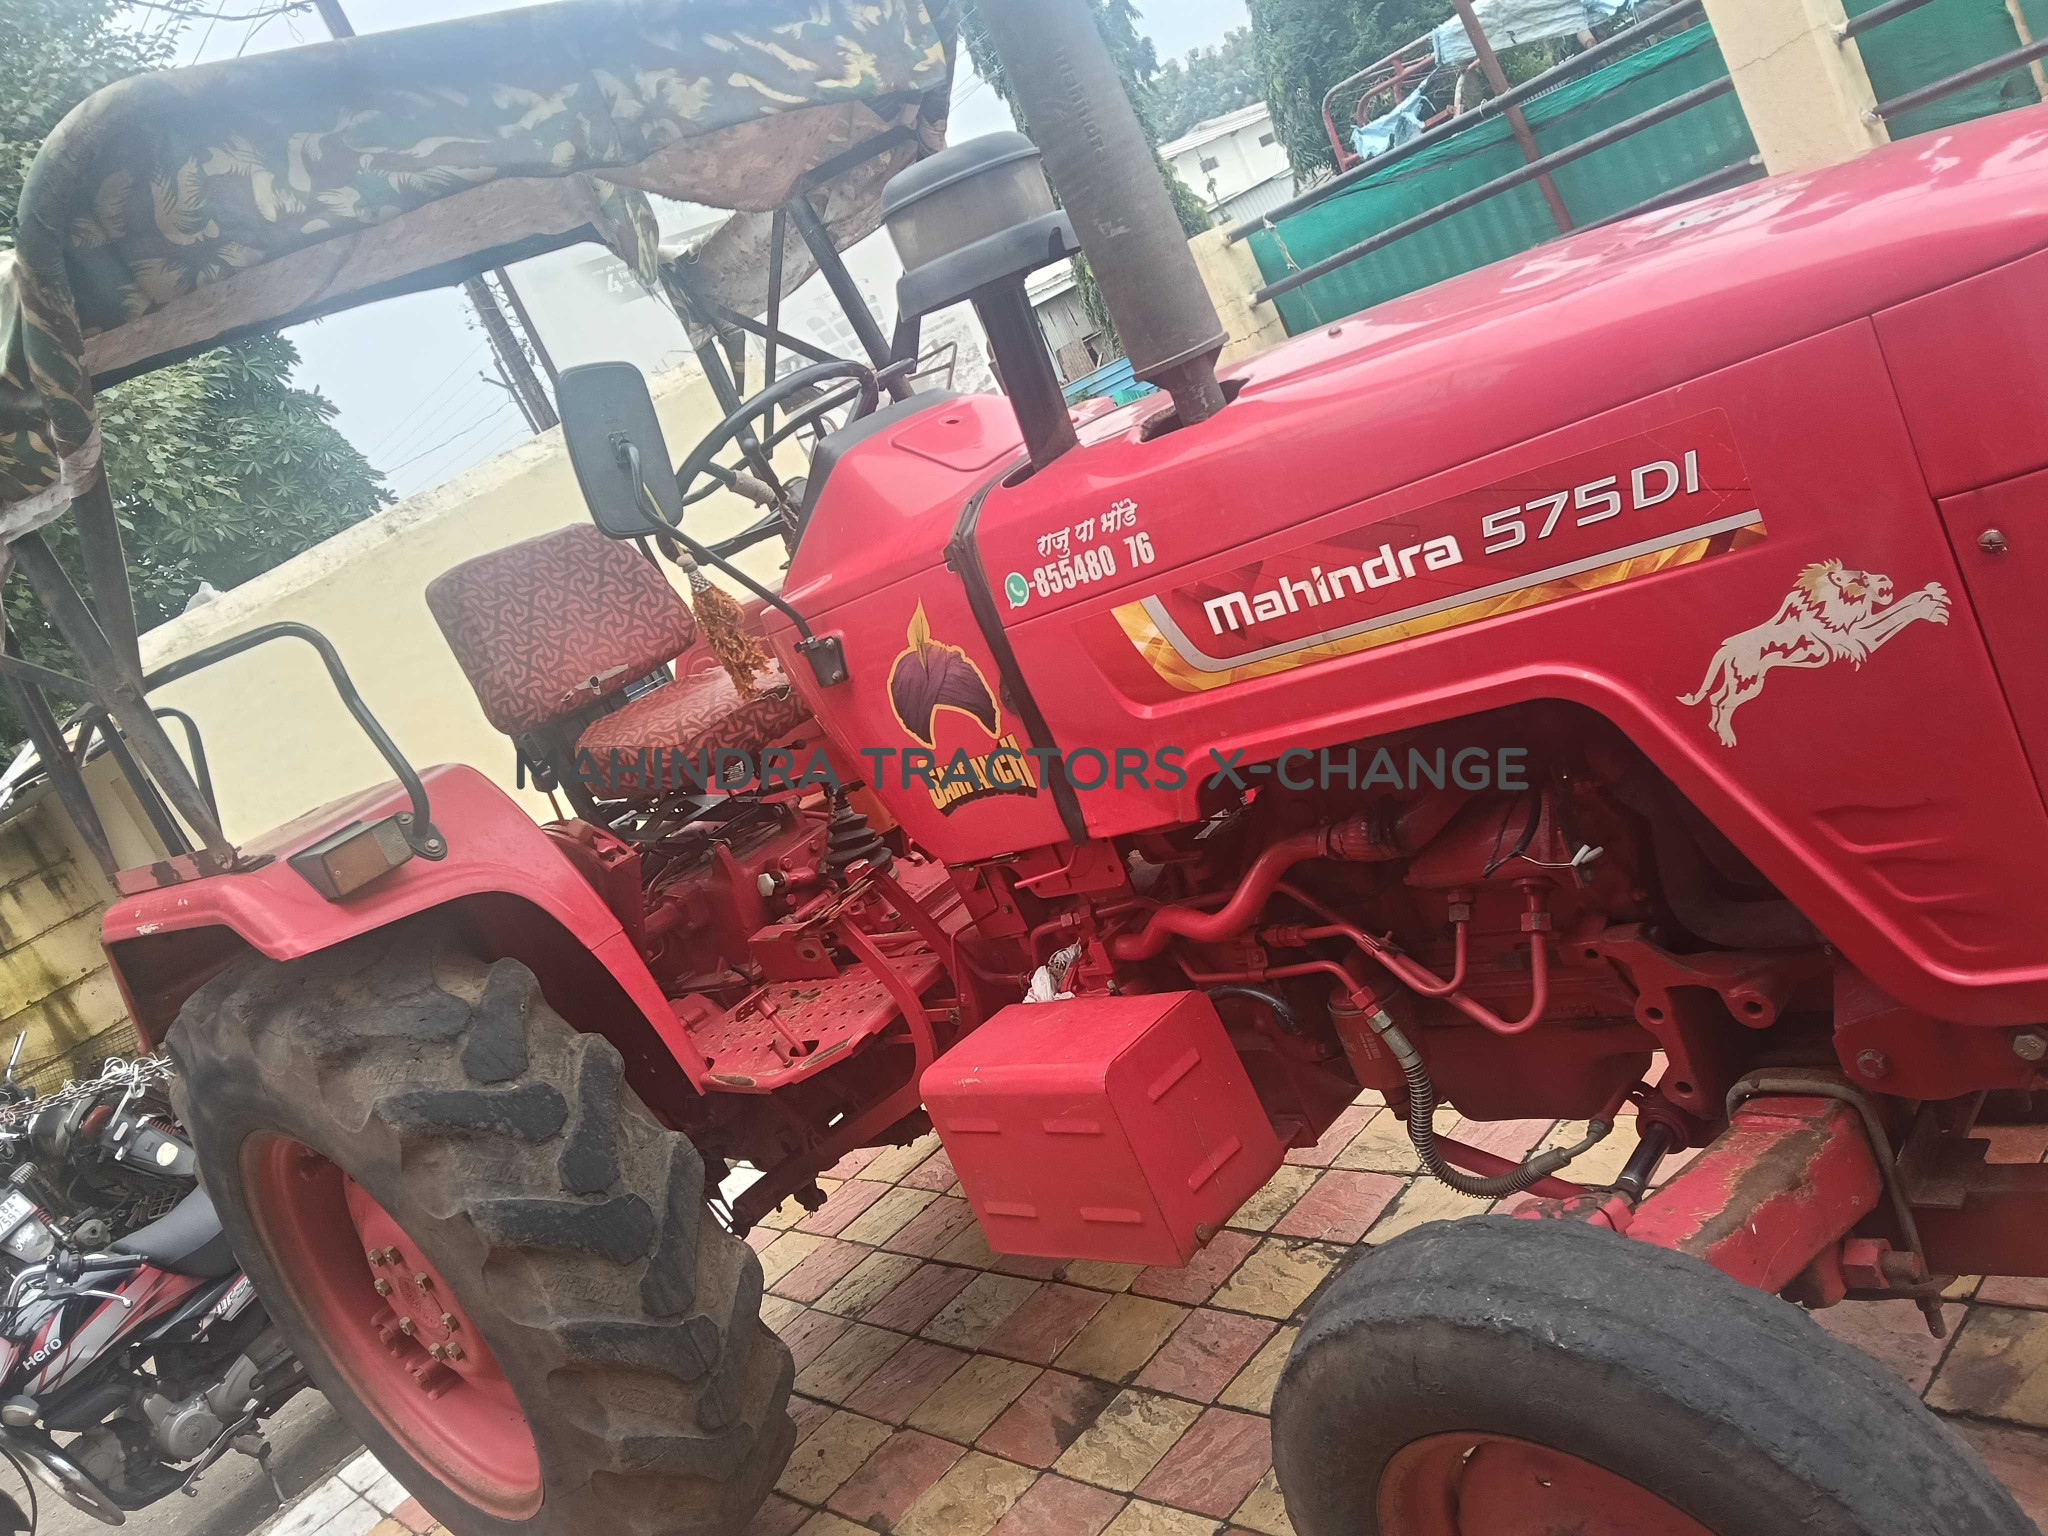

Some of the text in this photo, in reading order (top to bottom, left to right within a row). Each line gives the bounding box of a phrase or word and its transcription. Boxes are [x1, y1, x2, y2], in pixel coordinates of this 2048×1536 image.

[1123, 532, 1155, 568] 76
[1203, 534, 1464, 636] Mahindra
[22, 1338, 62, 1371] Hero
